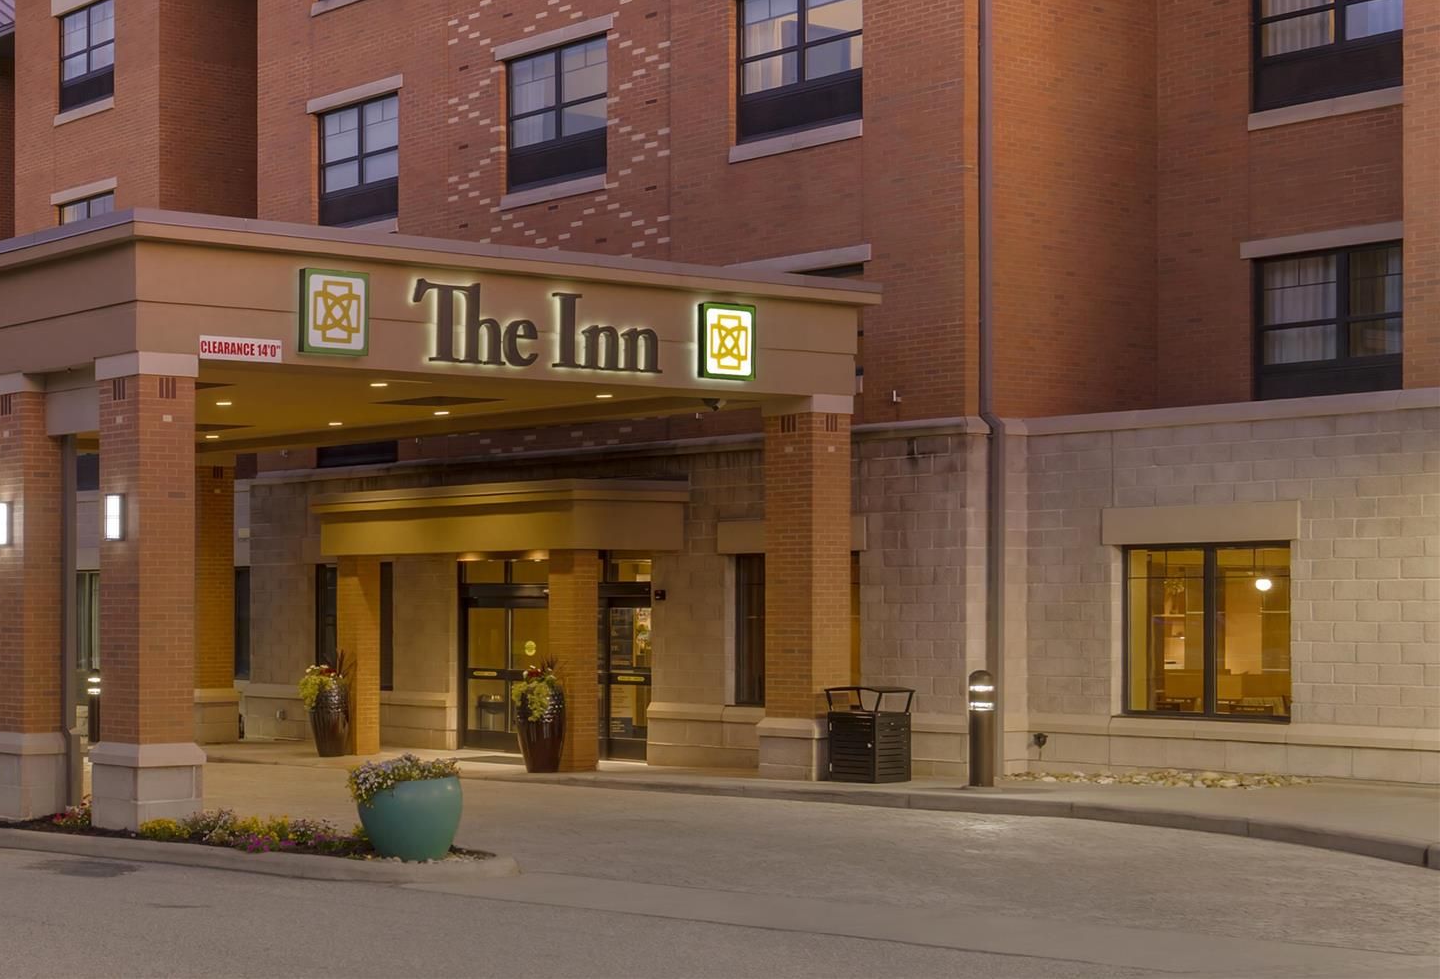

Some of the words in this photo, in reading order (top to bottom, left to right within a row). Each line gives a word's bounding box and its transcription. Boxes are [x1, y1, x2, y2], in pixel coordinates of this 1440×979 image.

[200, 340, 255, 357] CLEARANCE
[257, 343, 281, 358] 14'0"
[413, 278, 539, 367] The
[552, 292, 663, 374] Inn
